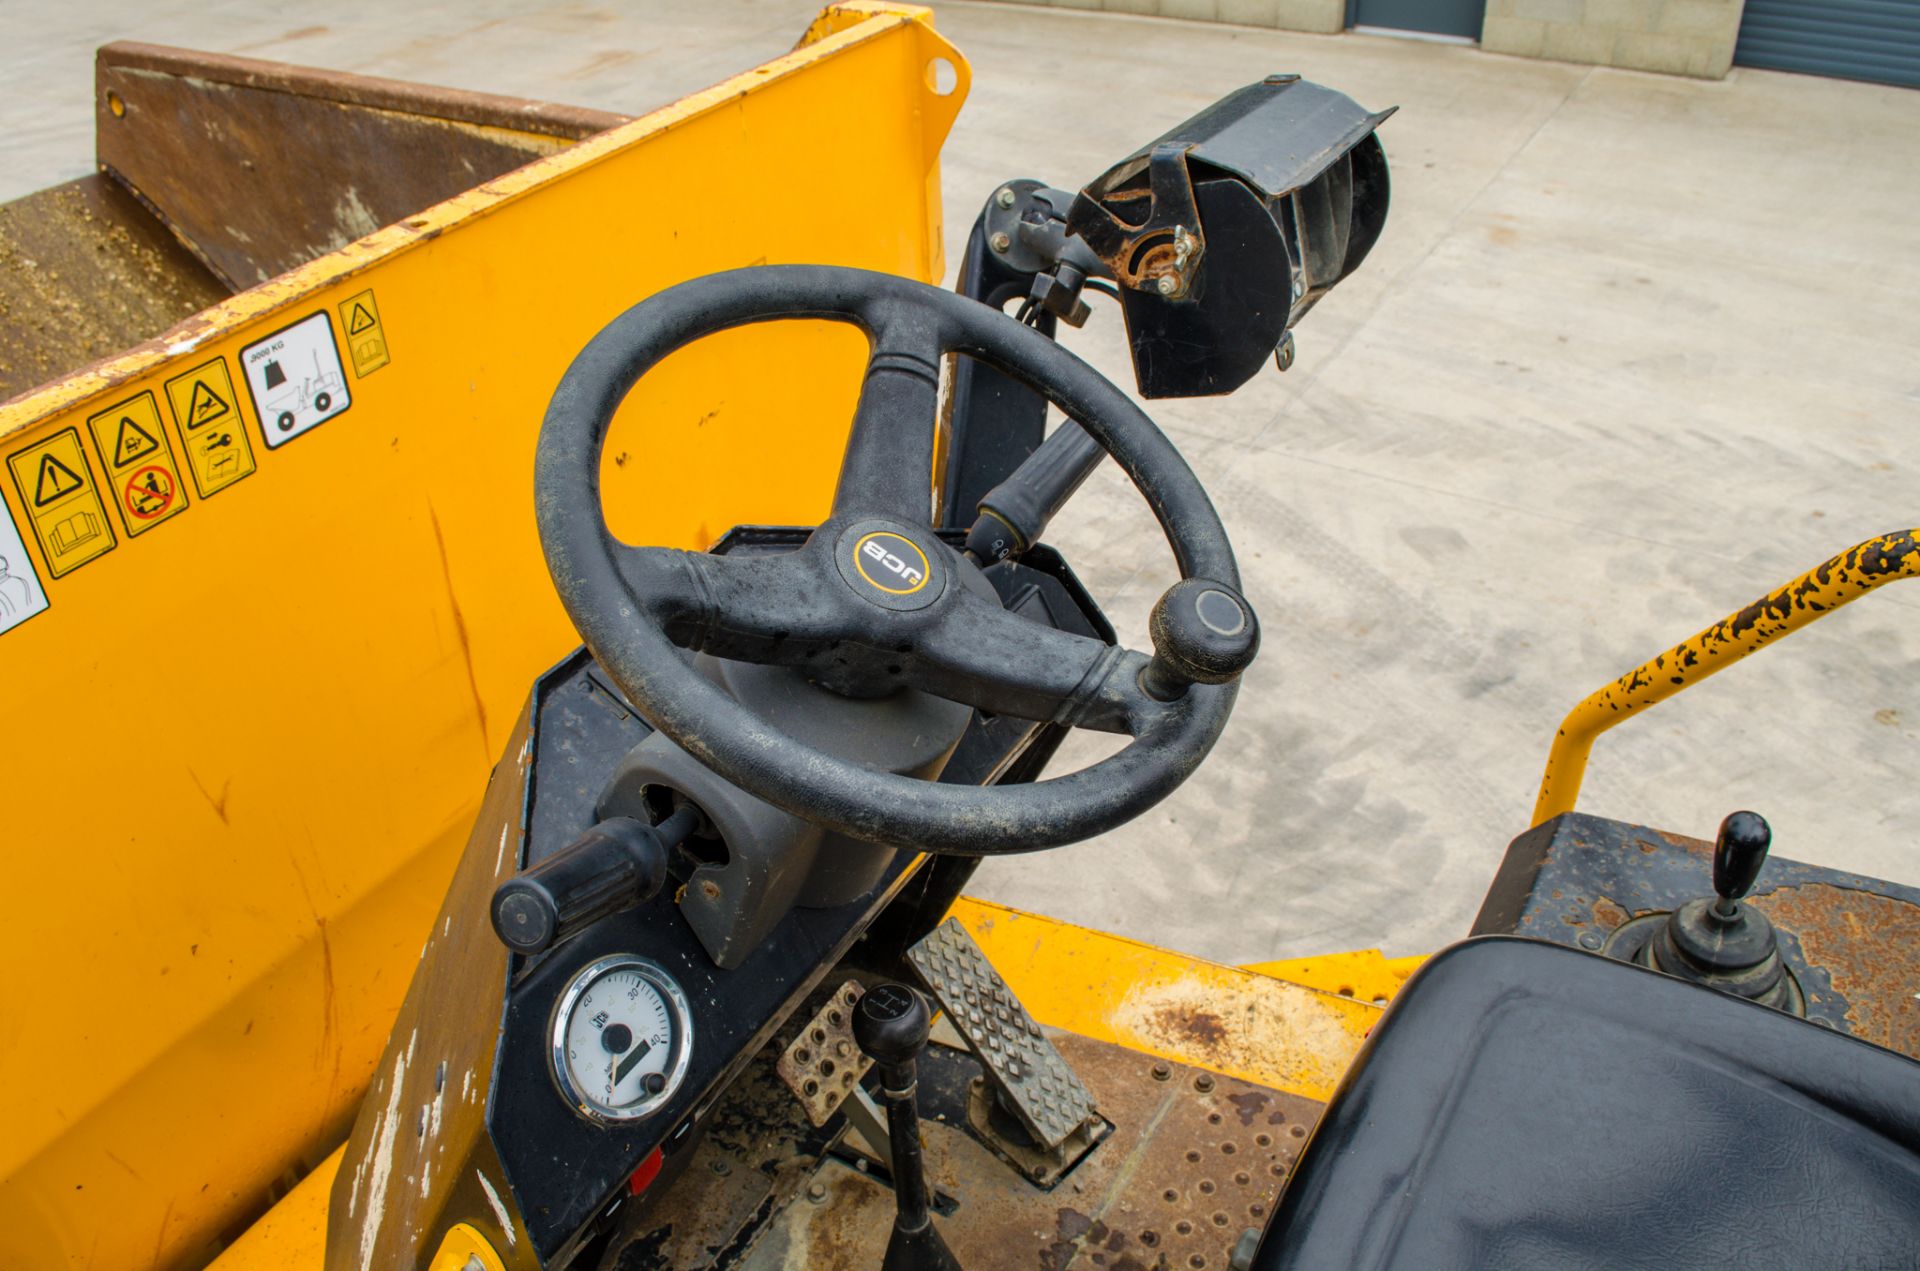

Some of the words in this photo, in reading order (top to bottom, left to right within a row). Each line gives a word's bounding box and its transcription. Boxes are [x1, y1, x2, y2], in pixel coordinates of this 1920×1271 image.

[272, 341, 284, 352] KG
[863, 540, 922, 585] JCB
[627, 987, 639, 1001] 30
[592, 1010, 609, 1028] JCB
[650, 1033, 661, 1047] 40
